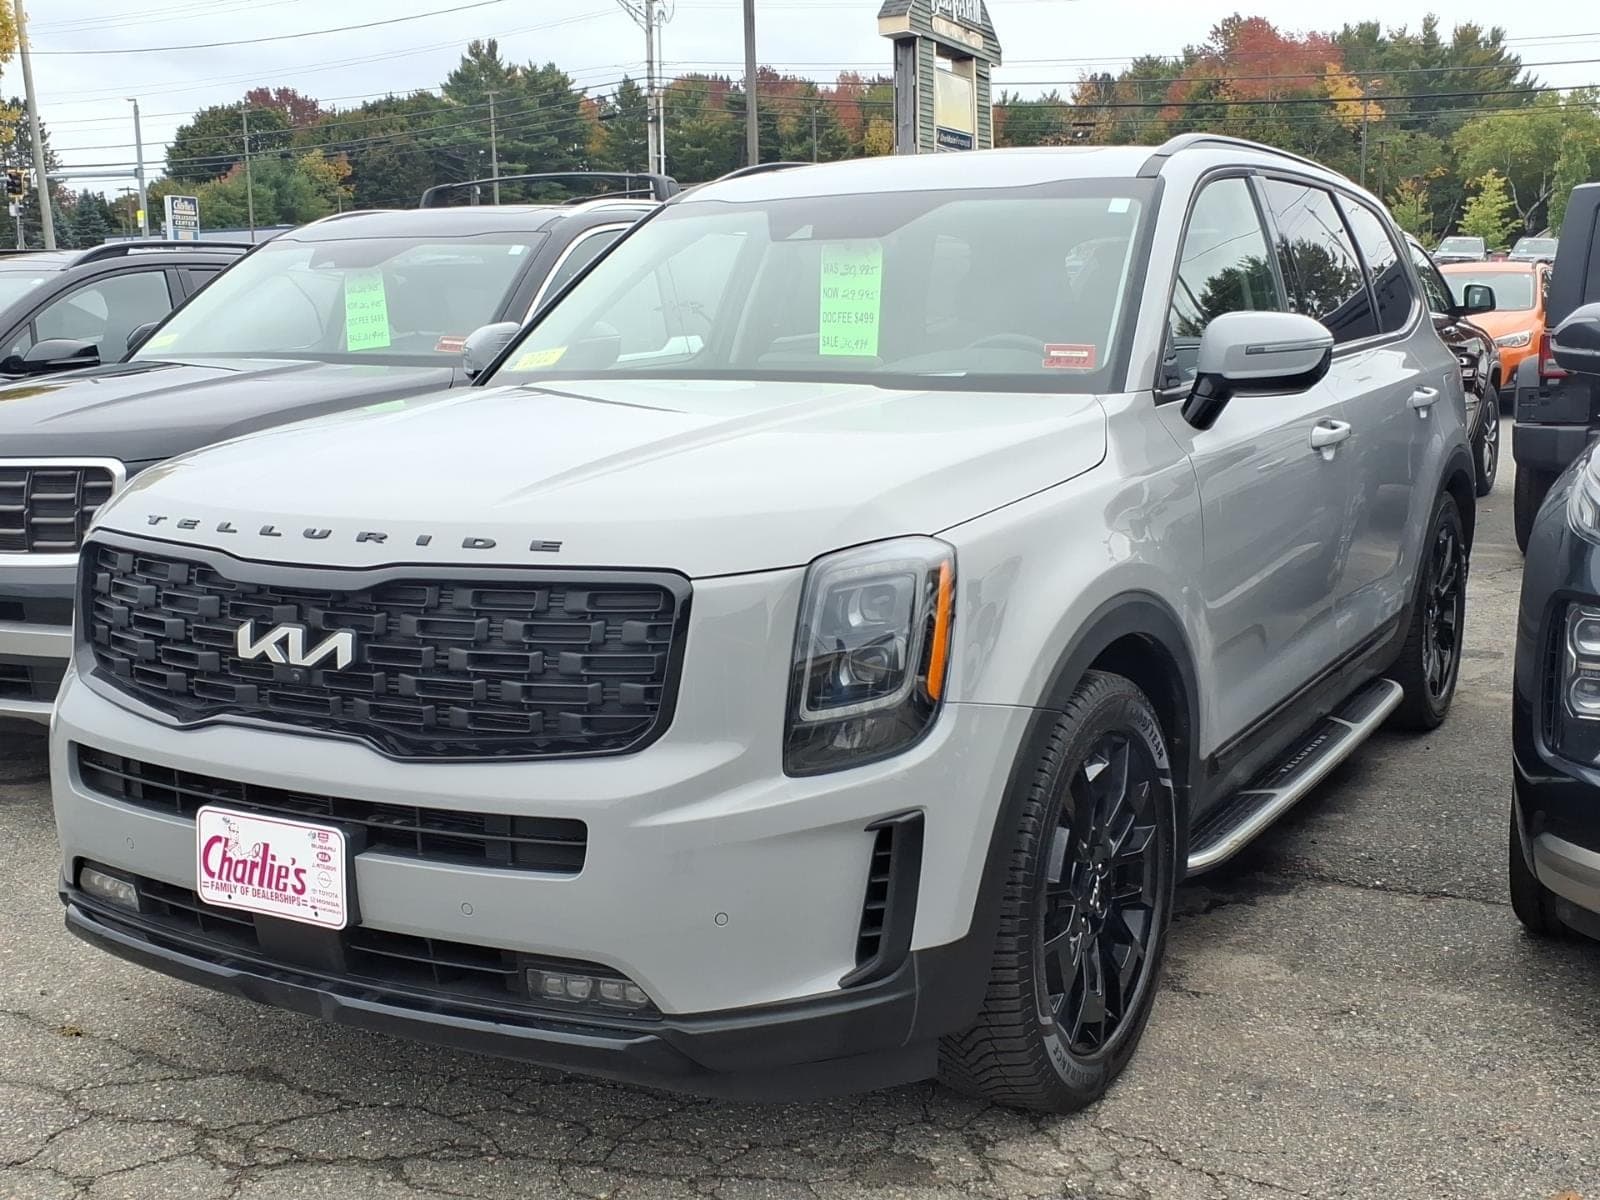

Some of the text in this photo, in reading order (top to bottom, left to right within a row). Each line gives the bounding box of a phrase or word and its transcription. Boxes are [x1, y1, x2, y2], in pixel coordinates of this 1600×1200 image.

[823, 287, 839, 299] NOW
[854, 311, 874, 324] $499
[822, 335, 838, 348] SALE
[147, 514, 563, 553] TELLURIDE
[1280, 735, 1327, 773] TELLURIDE
[311, 843, 336, 852] SUBARU
[202, 835, 307, 896] Charlie's
[210, 880, 301, 906] FAMILY OF DEALERSHIPS
[318, 889, 339, 899] TOYOTA
[316, 898, 339, 908] HONDA
